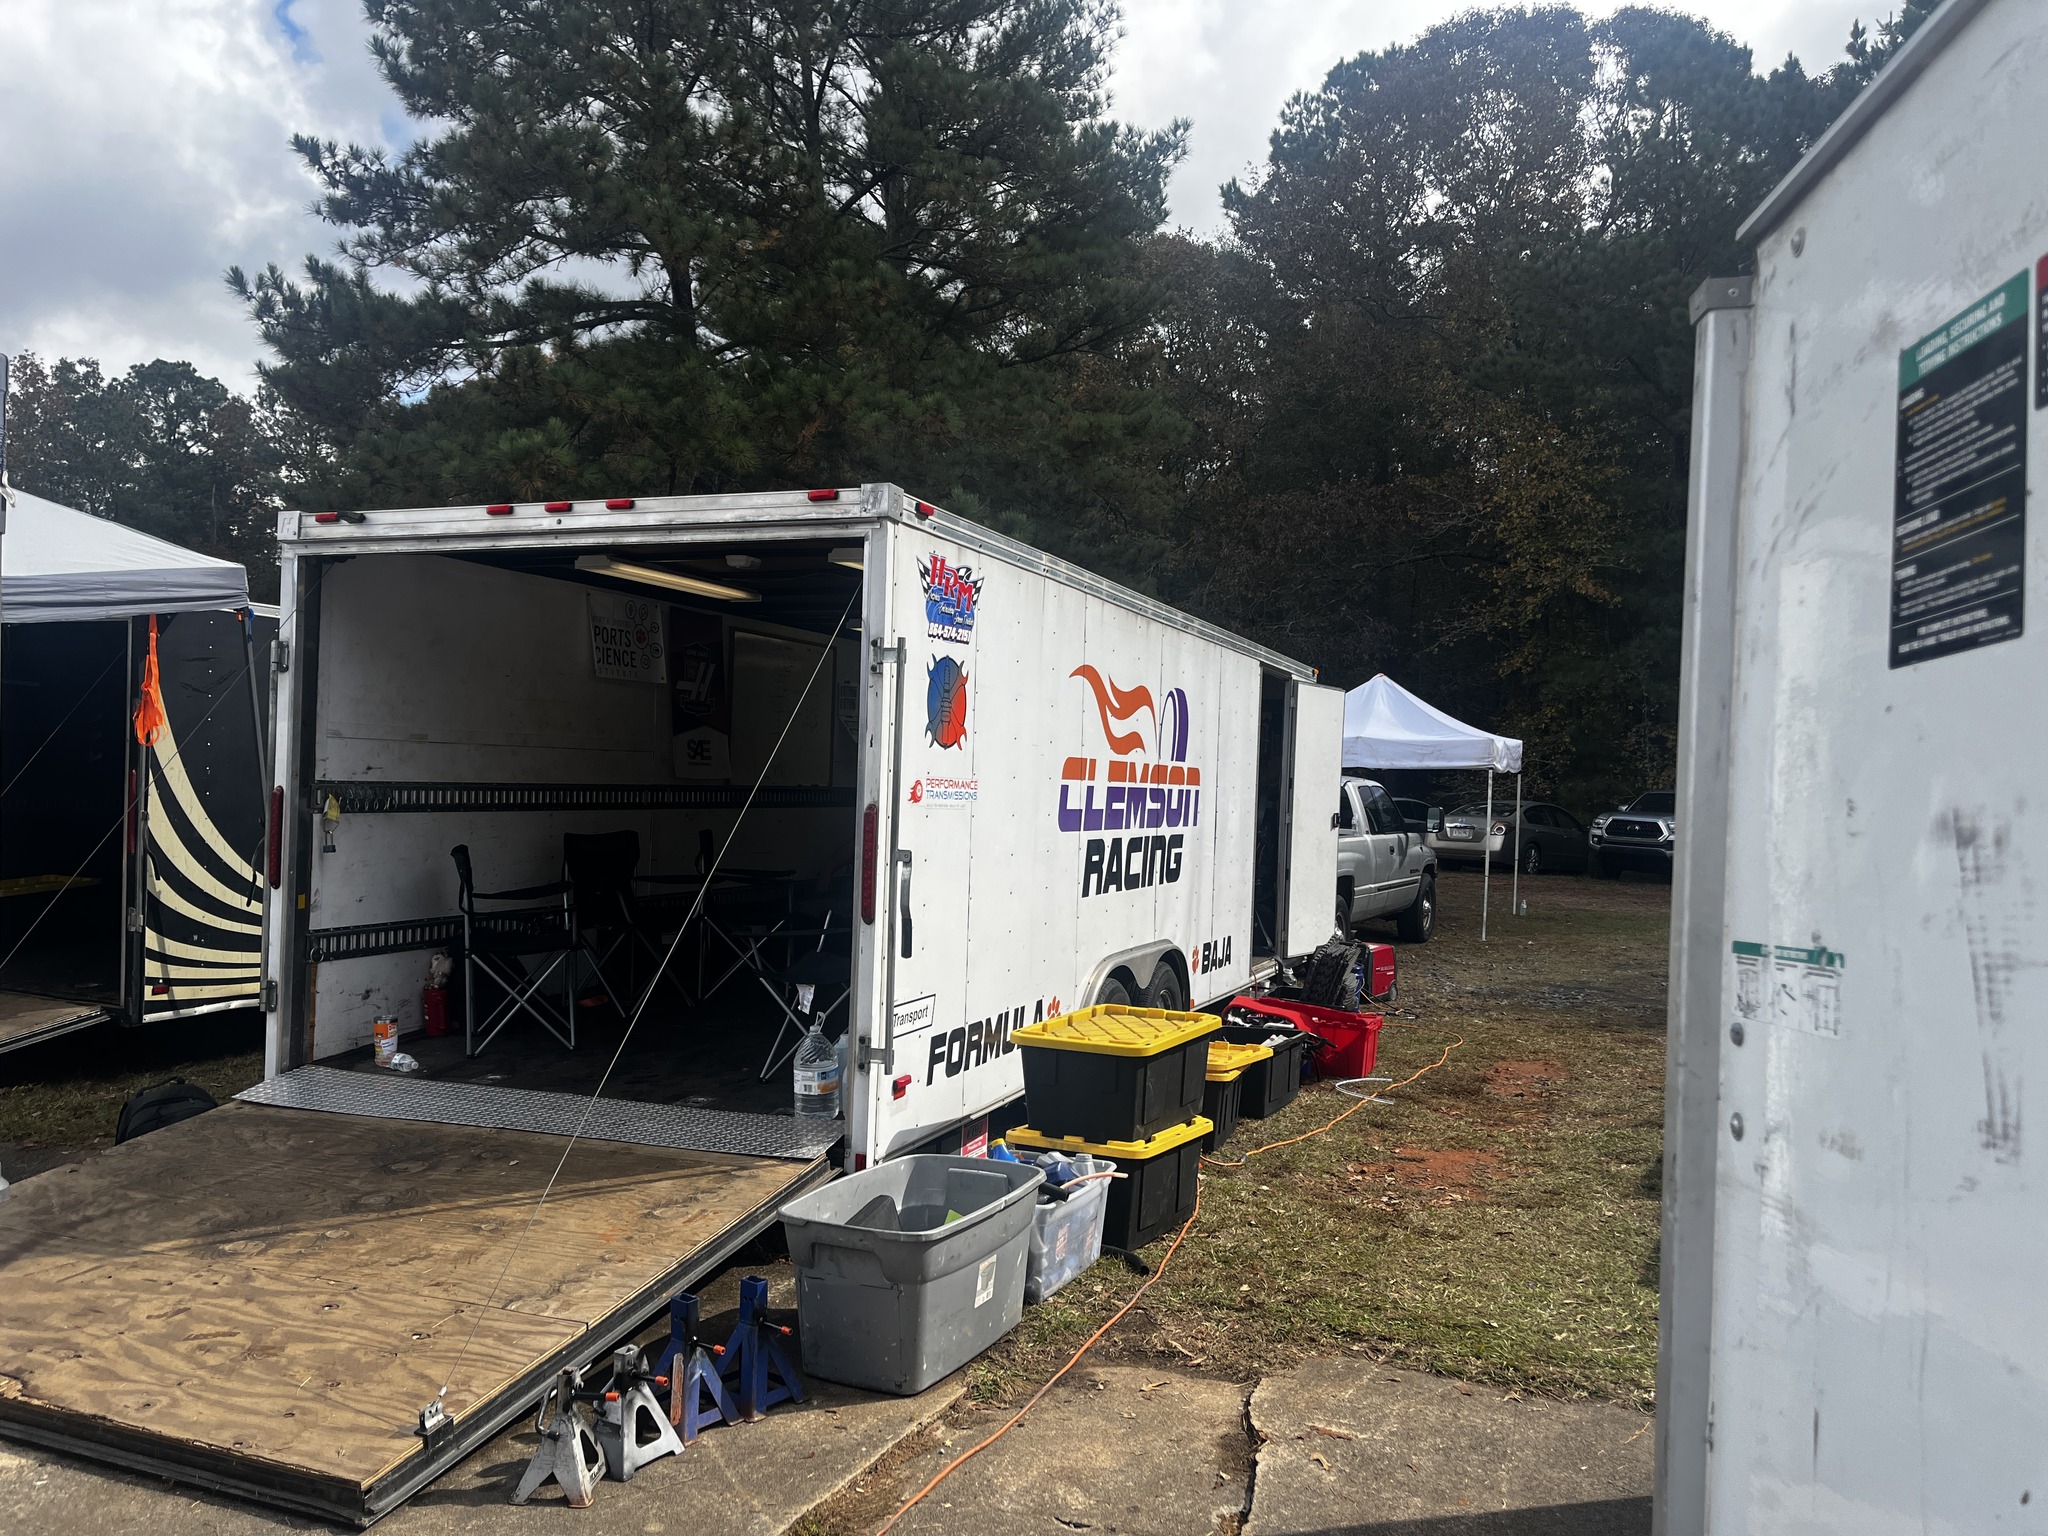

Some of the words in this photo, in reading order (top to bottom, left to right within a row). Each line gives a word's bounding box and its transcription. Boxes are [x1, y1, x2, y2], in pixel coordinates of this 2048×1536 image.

[928, 553, 974, 613] HRM
[594, 625, 631, 647] PORTS
[595, 646, 637, 668] CIENCE
[598, 667, 639, 679] STITUTE
[687, 738, 712, 760] SAE
[926, 778, 978, 790] PERFORMANCE
[926, 789, 977, 800] TRANSMISSIONS
[1058, 756, 1201, 832] CLEMSON
[1081, 834, 1184, 898] RACING
[1202, 935, 1232, 974] BAJA
[893, 1004, 928, 1027] Transport
[926, 999, 1044, 1086] FORMULA
